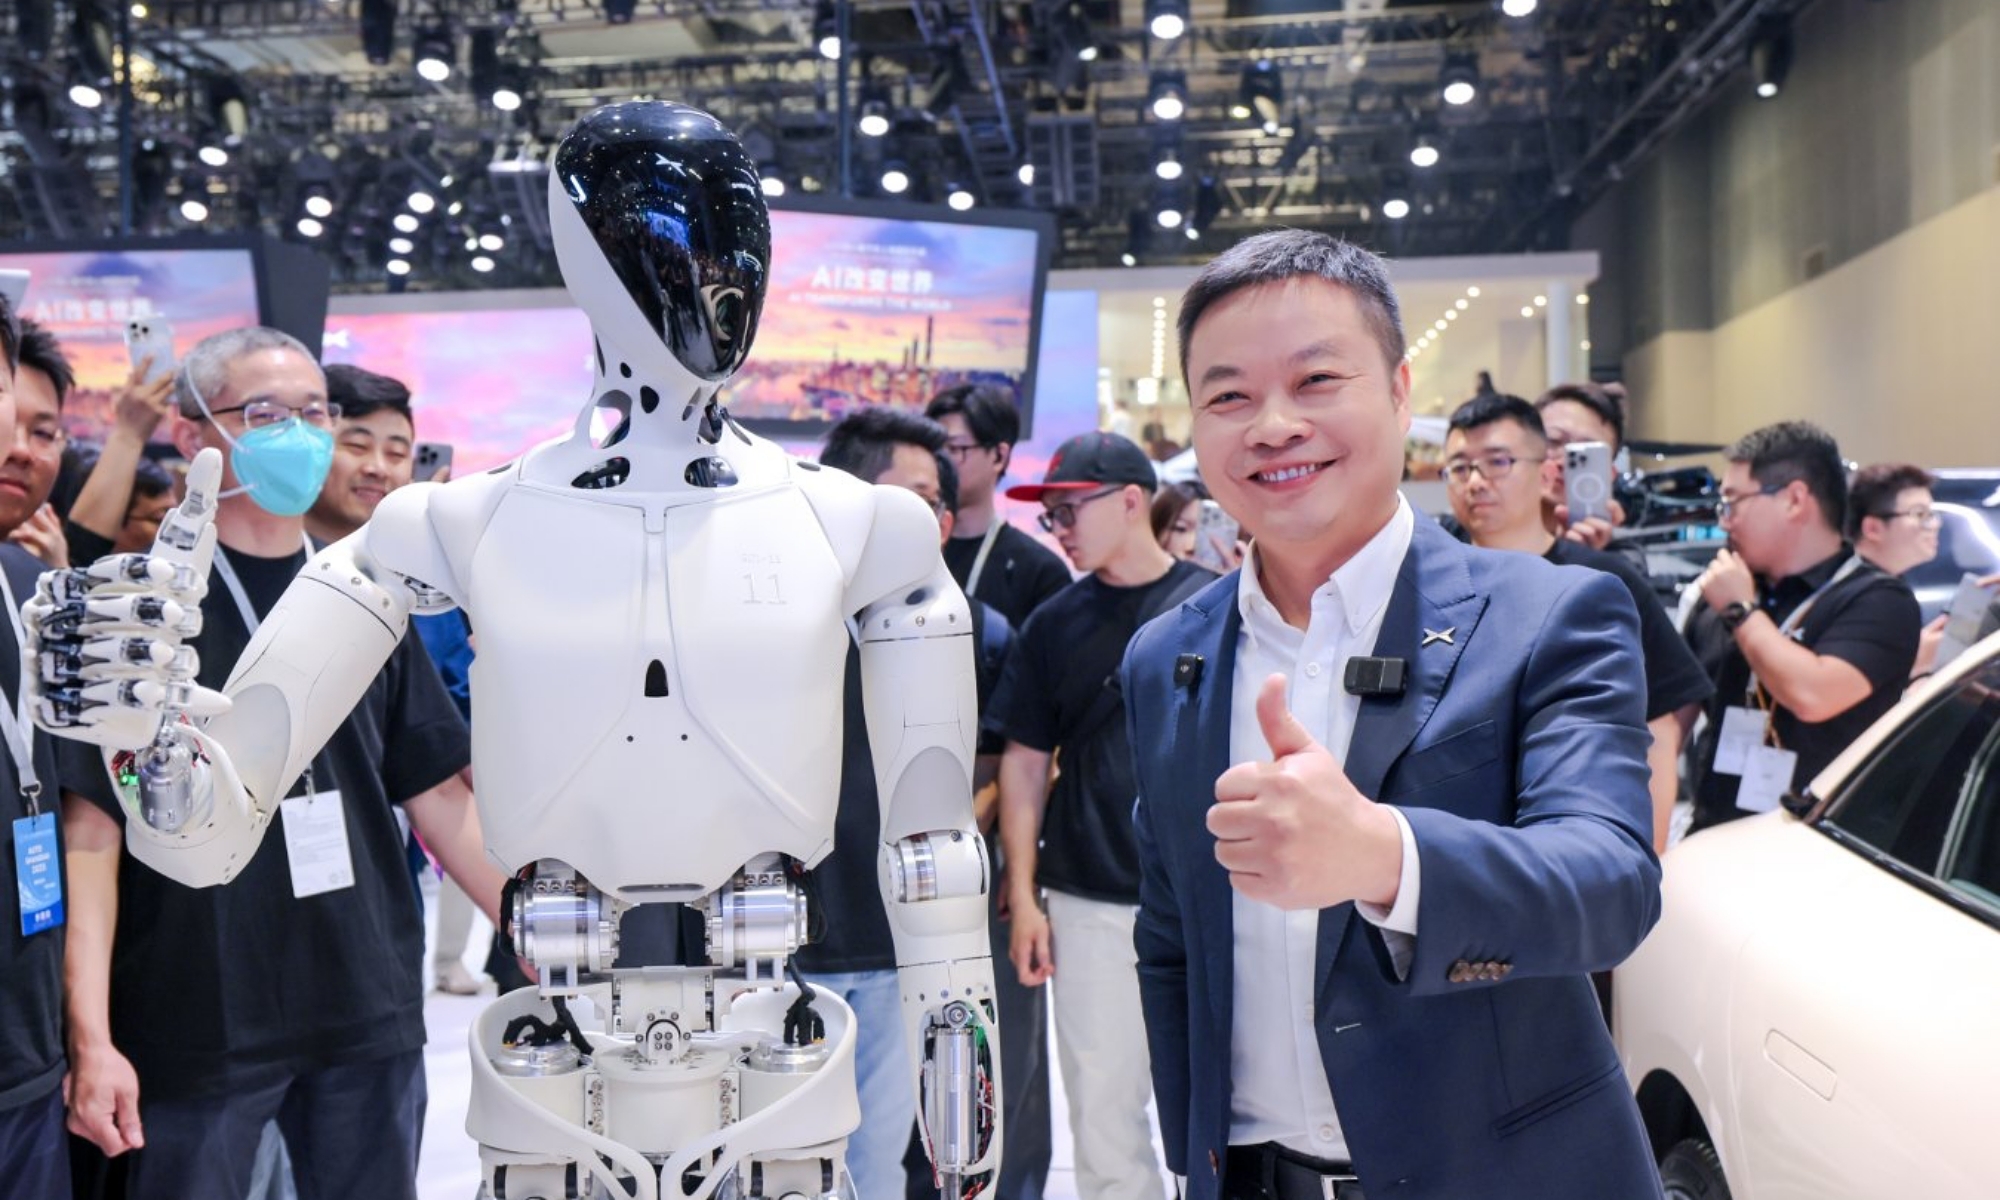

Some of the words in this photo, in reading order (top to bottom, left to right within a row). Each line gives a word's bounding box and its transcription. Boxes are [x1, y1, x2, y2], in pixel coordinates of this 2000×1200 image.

[811, 265, 934, 293] AI改变世界
[742, 573, 788, 605] 11
